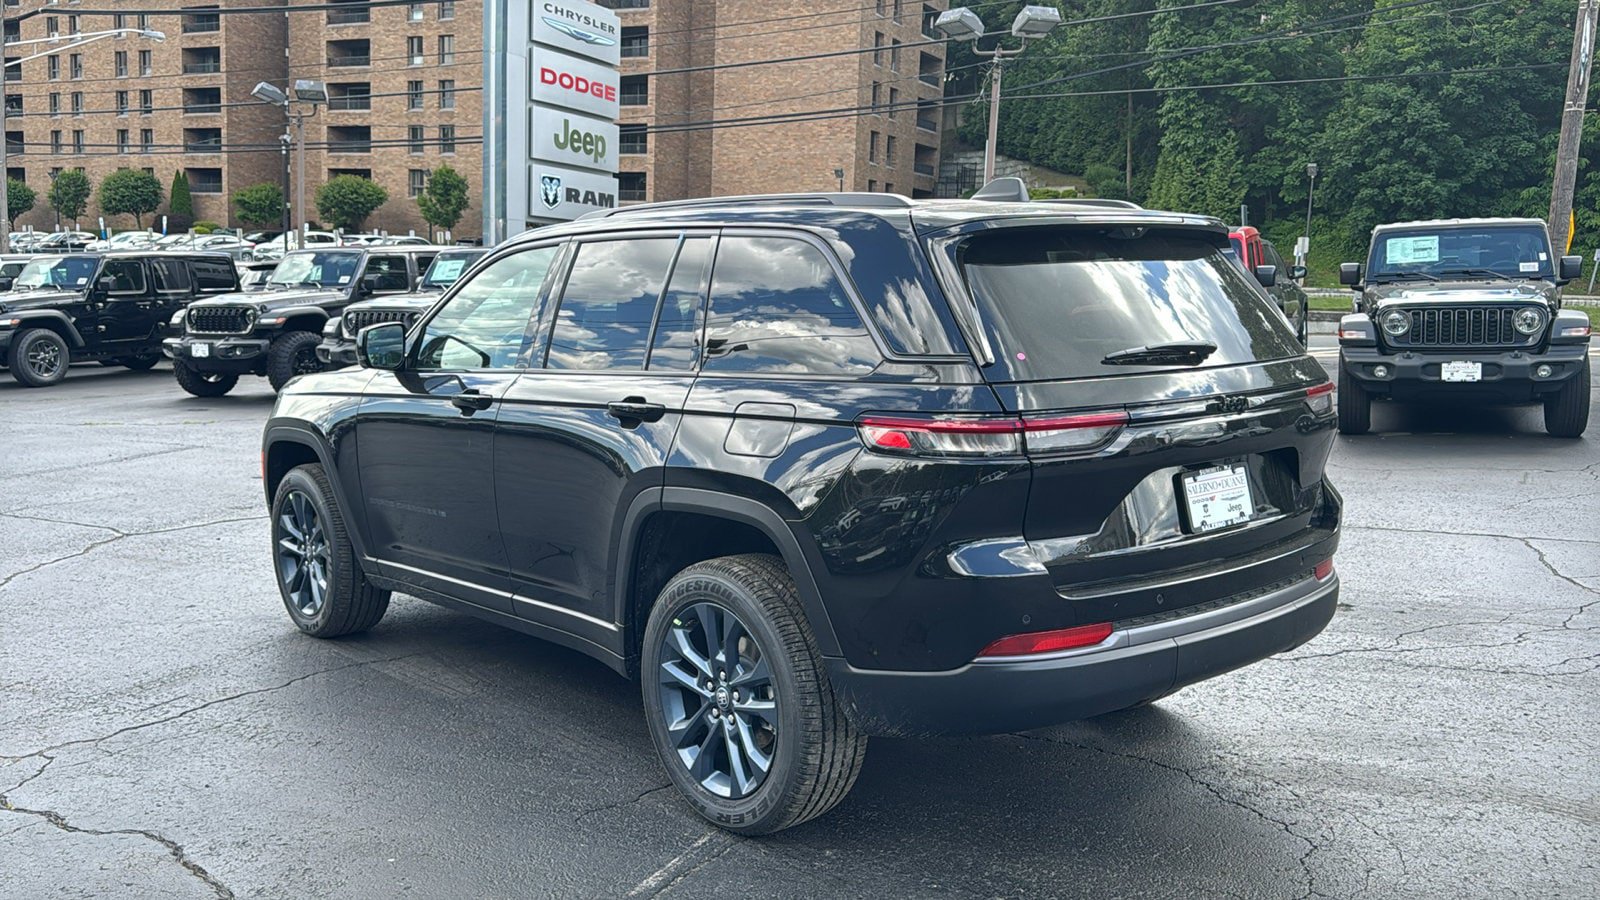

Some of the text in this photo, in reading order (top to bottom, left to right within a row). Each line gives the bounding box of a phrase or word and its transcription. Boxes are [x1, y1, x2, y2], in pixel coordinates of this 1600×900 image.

[544, 3, 615, 35] CHRYSLER
[541, 67, 616, 102] DODGE
[554, 119, 606, 163] Jeep
[565, 187, 614, 208] RAM
[1227, 503, 1242, 512] Jeep
[655, 580, 743, 618] RIDGESTONE
